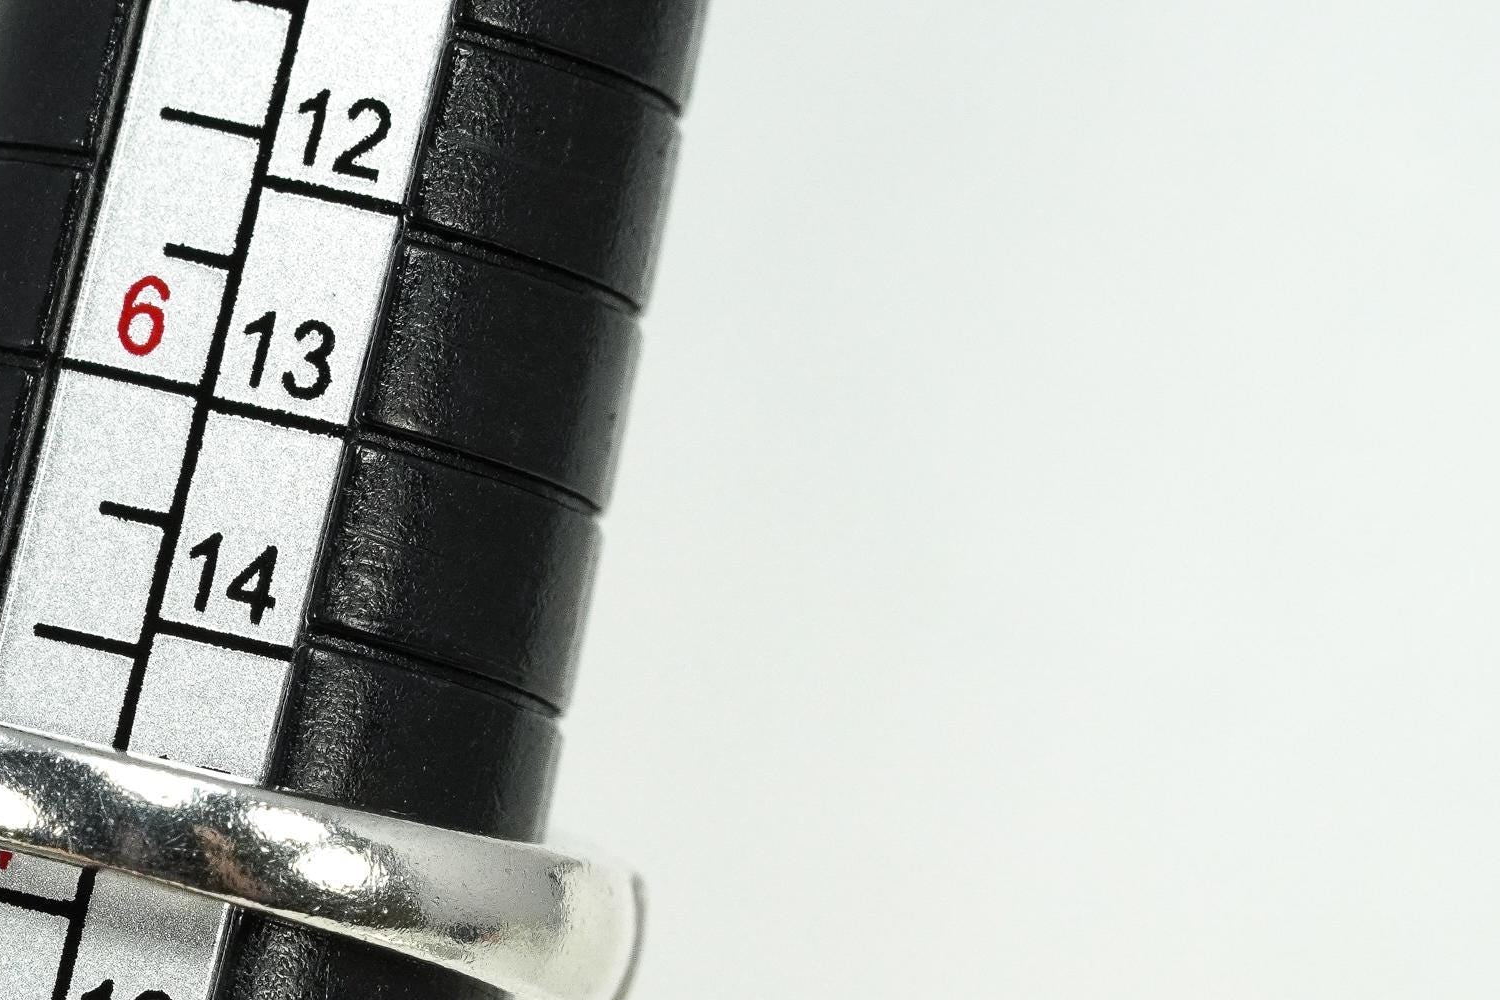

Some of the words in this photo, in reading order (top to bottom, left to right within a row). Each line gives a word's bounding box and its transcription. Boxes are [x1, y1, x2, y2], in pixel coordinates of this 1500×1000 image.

[297, 88, 392, 184] 12
[117, 275, 171, 357] 6
[243, 310, 336, 401] 13
[188, 531, 279, 627] 14
